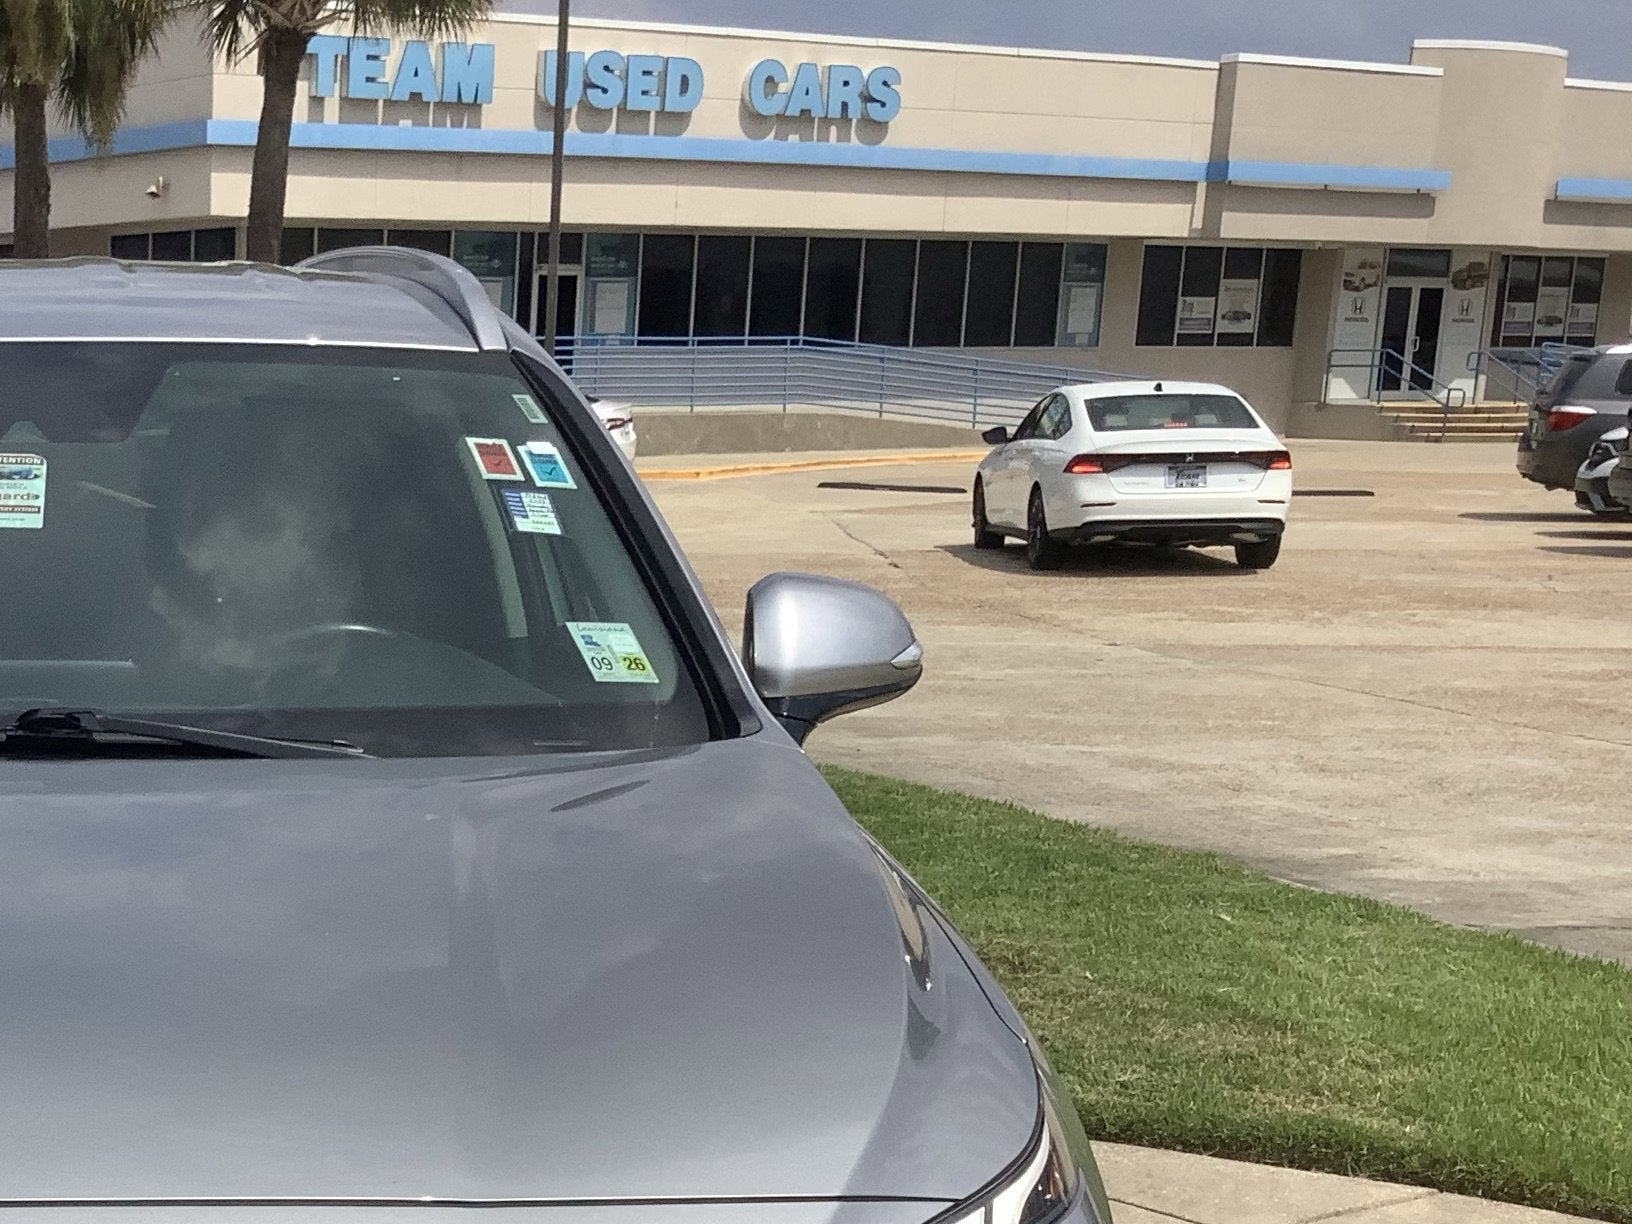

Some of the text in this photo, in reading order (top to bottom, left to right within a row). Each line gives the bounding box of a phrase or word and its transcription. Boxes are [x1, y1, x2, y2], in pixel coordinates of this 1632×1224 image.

[306, 34, 902, 123] TEAM USED CARS
[590, 656, 646, 671] 09 26
